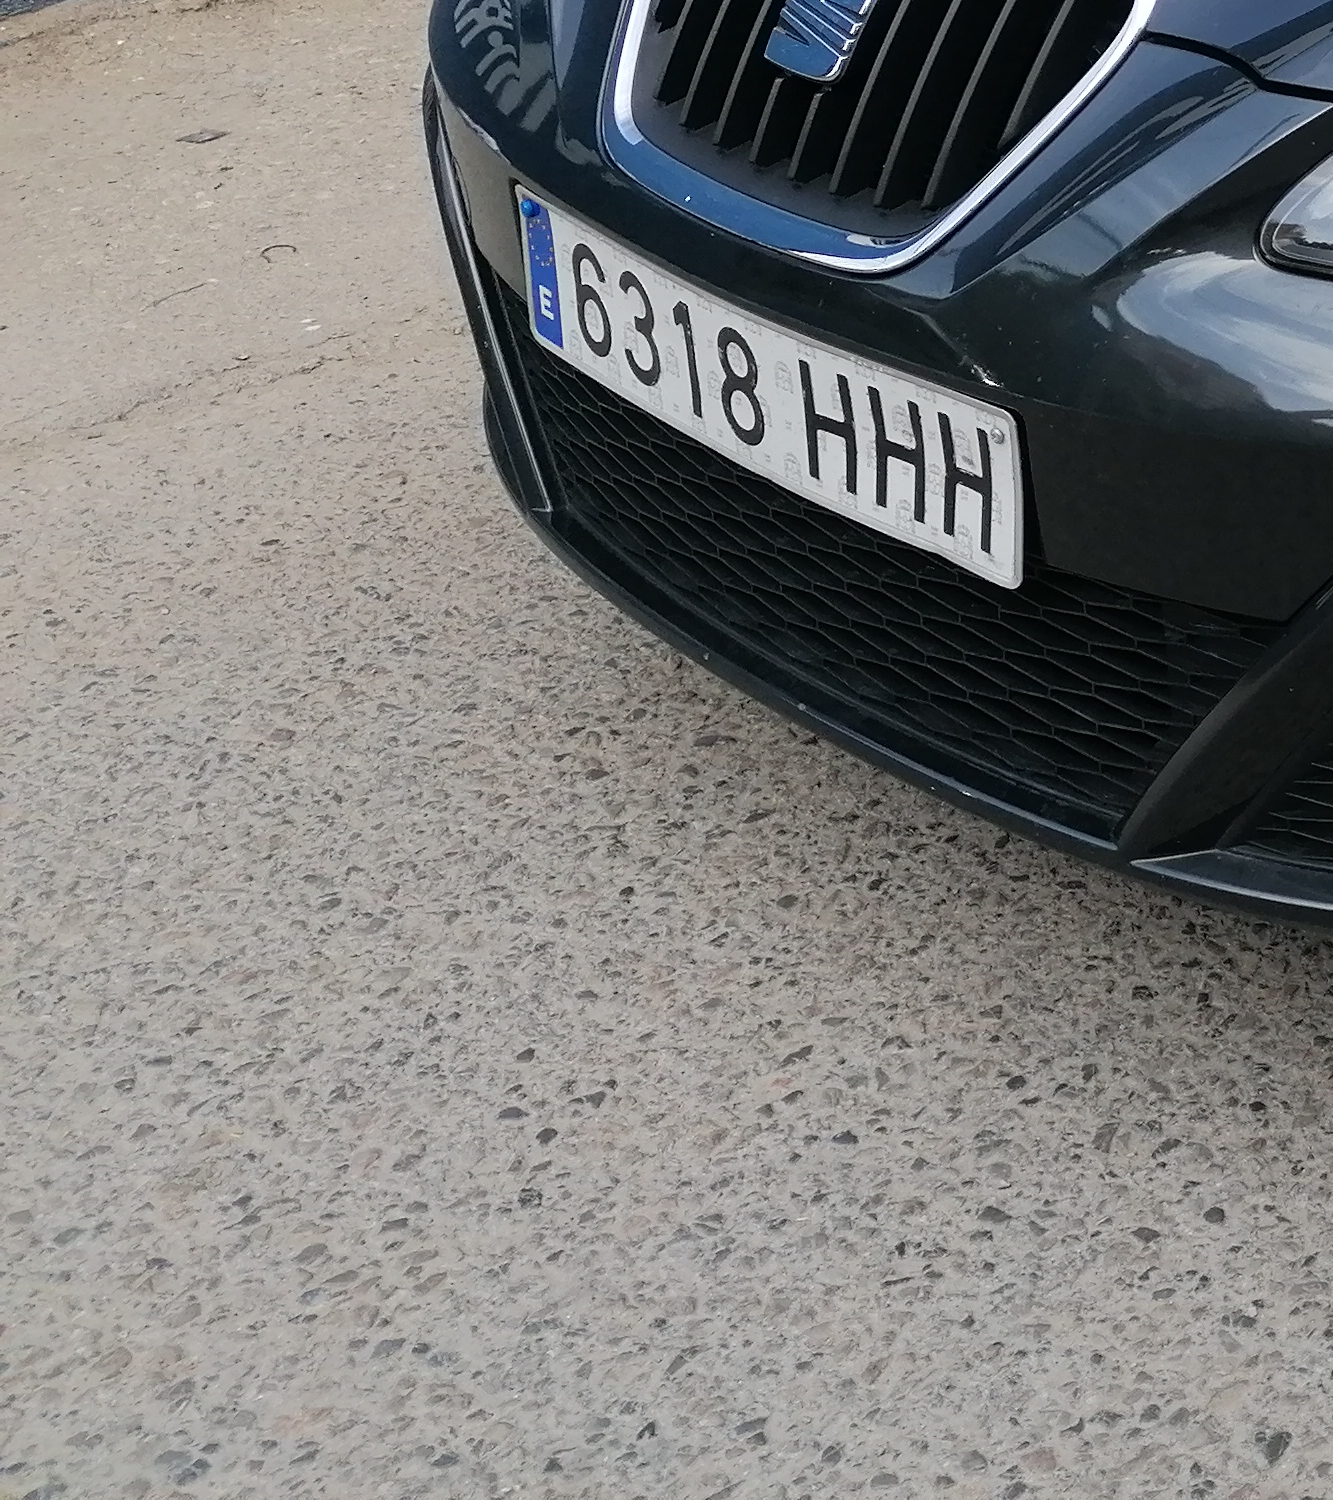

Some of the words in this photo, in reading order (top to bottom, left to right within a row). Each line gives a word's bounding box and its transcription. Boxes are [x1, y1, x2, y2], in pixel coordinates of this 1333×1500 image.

[539, 284, 555, 321] E
[571, 242, 765, 447] 6318
[798, 358, 993, 554] HHH
